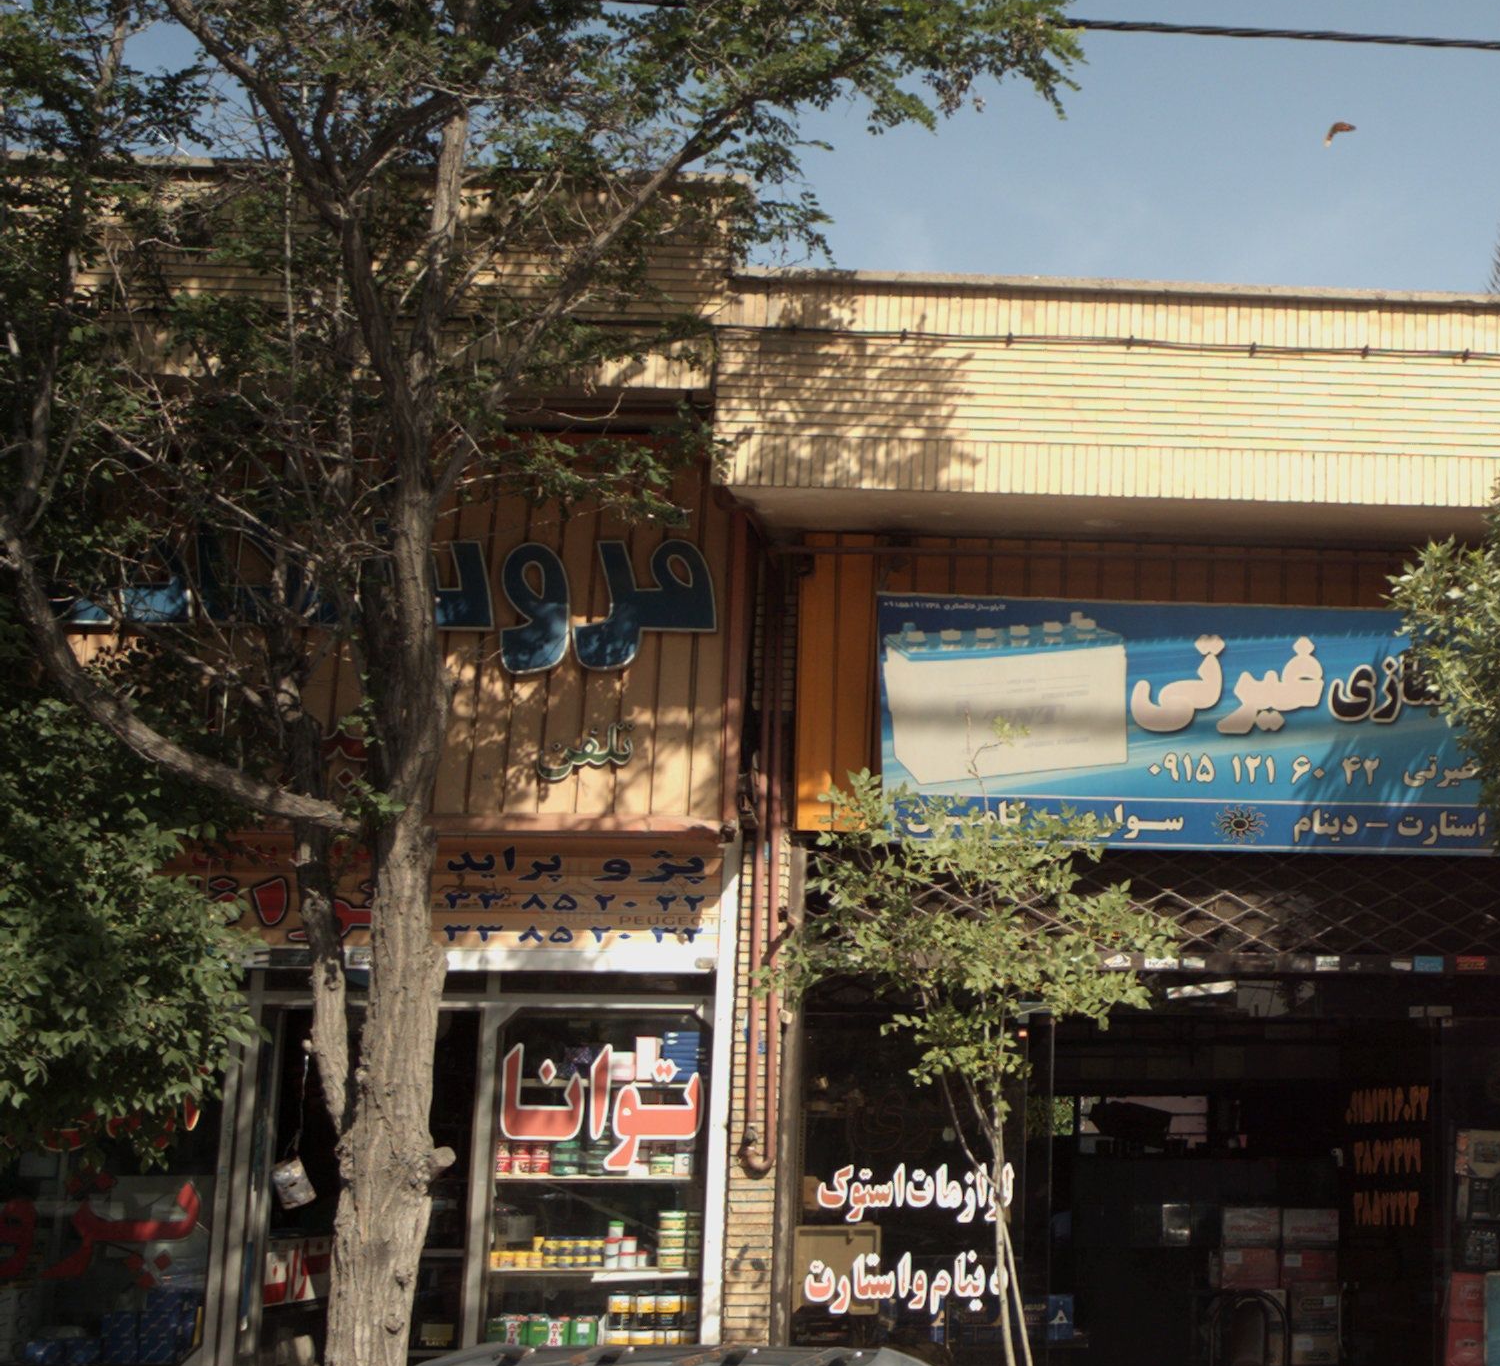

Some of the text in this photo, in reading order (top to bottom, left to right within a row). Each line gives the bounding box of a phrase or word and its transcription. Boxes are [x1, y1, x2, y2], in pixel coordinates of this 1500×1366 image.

[1131, 635, 1324, 735] غیرتی
[537, 723, 636, 782] تلفن
[1149, 751, 1216, 783] ۰۹۱۵
[1232, 754, 1276, 784] ۱۲۱
[1292, 754, 1326, 785] ۶۰
[1342, 755, 1380, 785] ۴۲
[1293, 808, 1487, 845] استارت دینام
[446, 845, 563, 882] پراید
[619, 915, 717, 926] PEUGEOT
[501, 1043, 704, 1171] توانا
[816, 1162, 905, 1223] استوک
[804, 1251, 913, 1315] استارت
